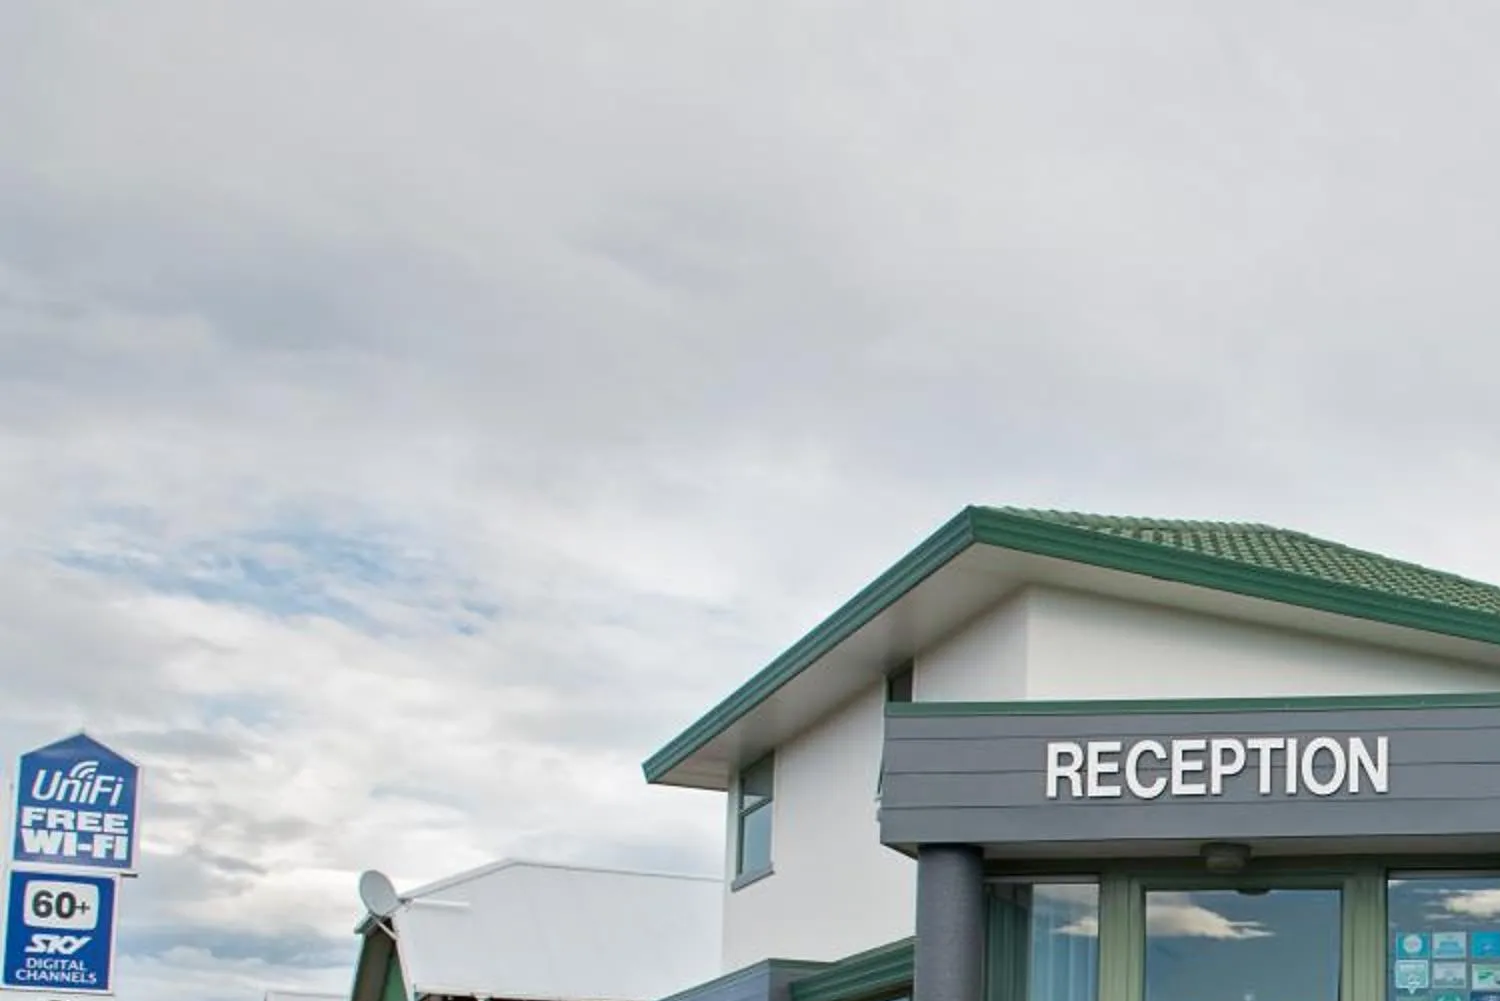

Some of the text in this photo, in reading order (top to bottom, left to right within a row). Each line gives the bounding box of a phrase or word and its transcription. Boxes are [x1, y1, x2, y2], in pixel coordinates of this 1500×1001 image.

[1046, 736, 1389, 800] RECEPTION
[31, 765, 124, 807] UniFi
[21, 806, 129, 834] FREE
[20, 827, 129, 860] WI-FI
[32, 889, 91, 919] 60+
[24, 933, 93, 955] SKY
[15, 969, 97, 984] CHANNELS
[25, 957, 88, 972] DIGITAL
